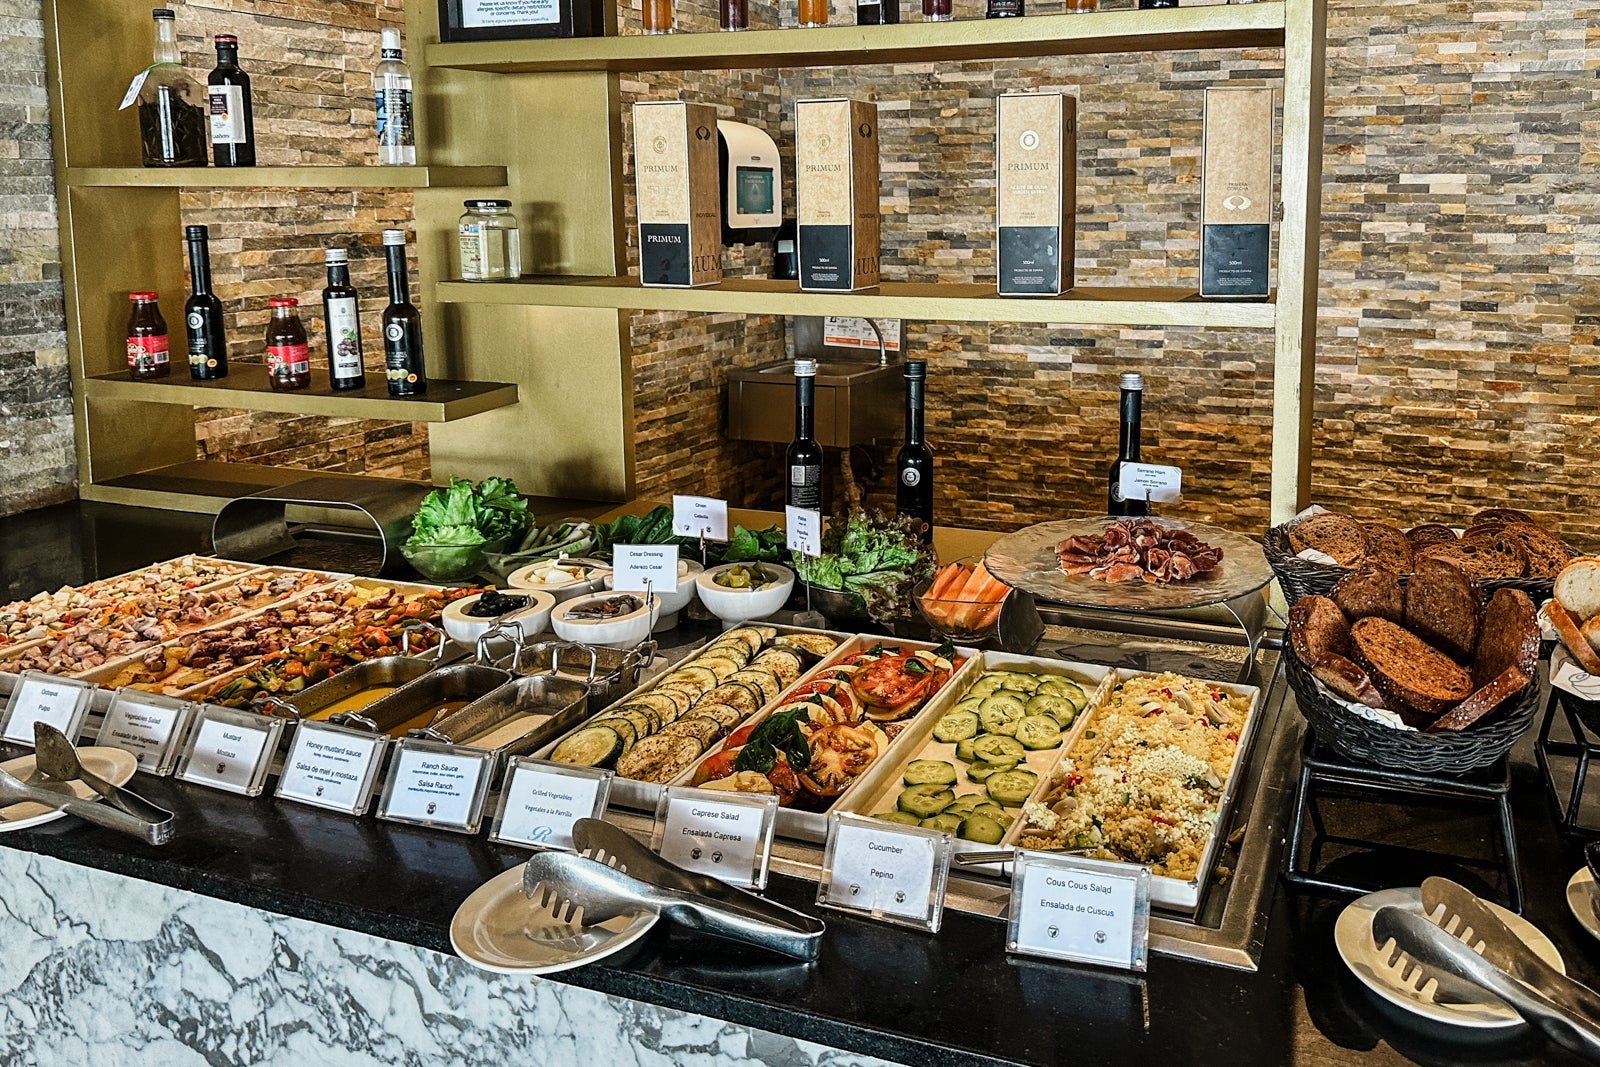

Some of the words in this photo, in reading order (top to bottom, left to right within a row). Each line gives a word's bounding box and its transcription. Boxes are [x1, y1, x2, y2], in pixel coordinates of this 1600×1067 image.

[643, 165, 678, 173] PRIMUM
[806, 164, 841, 172] PRIMUM
[1007, 162, 1049, 171] PRIMUM
[647, 234, 681, 243] PRIMUM
[222, 731, 242, 742] Mustard
[216, 748, 236, 758] Mostaza
[306, 740, 323, 751] Honey
[324, 745, 346, 754] mustard
[345, 749, 362, 758] sauce
[295, 761, 311, 772] Salsa
[319, 766, 331, 776] miel
[335, 771, 358, 781] mostaza
[421, 761, 440, 770] Ranch
[440, 763, 459, 772] Sauce
[417, 779, 434, 788] Salsa
[434, 781, 453, 790] Ranch
[532, 788, 548, 797] Grilled
[548, 791, 573, 801] Vegetables
[525, 804, 546, 813] Vegetales
[555, 809, 573, 818] Parrilla
[691, 808, 719, 818] Caprese
[720, 811, 740, 821] Salad
[527, 825, 553, 843] R
[682, 827, 713, 838] Ensalada
[713, 831, 741, 842] Capresa
[868, 841, 903, 854] Cucumber
[870, 868, 894, 880] Pepino
[1046, 876, 1066, 888] Cous
[1067, 879, 1088, 891] Cous
[1089, 883, 1112, 895] Salad
[1040, 898, 1074, 912] Ensalada
[1075, 903, 1086, 913] de
[1087, 906, 1115, 917] Cuscus
